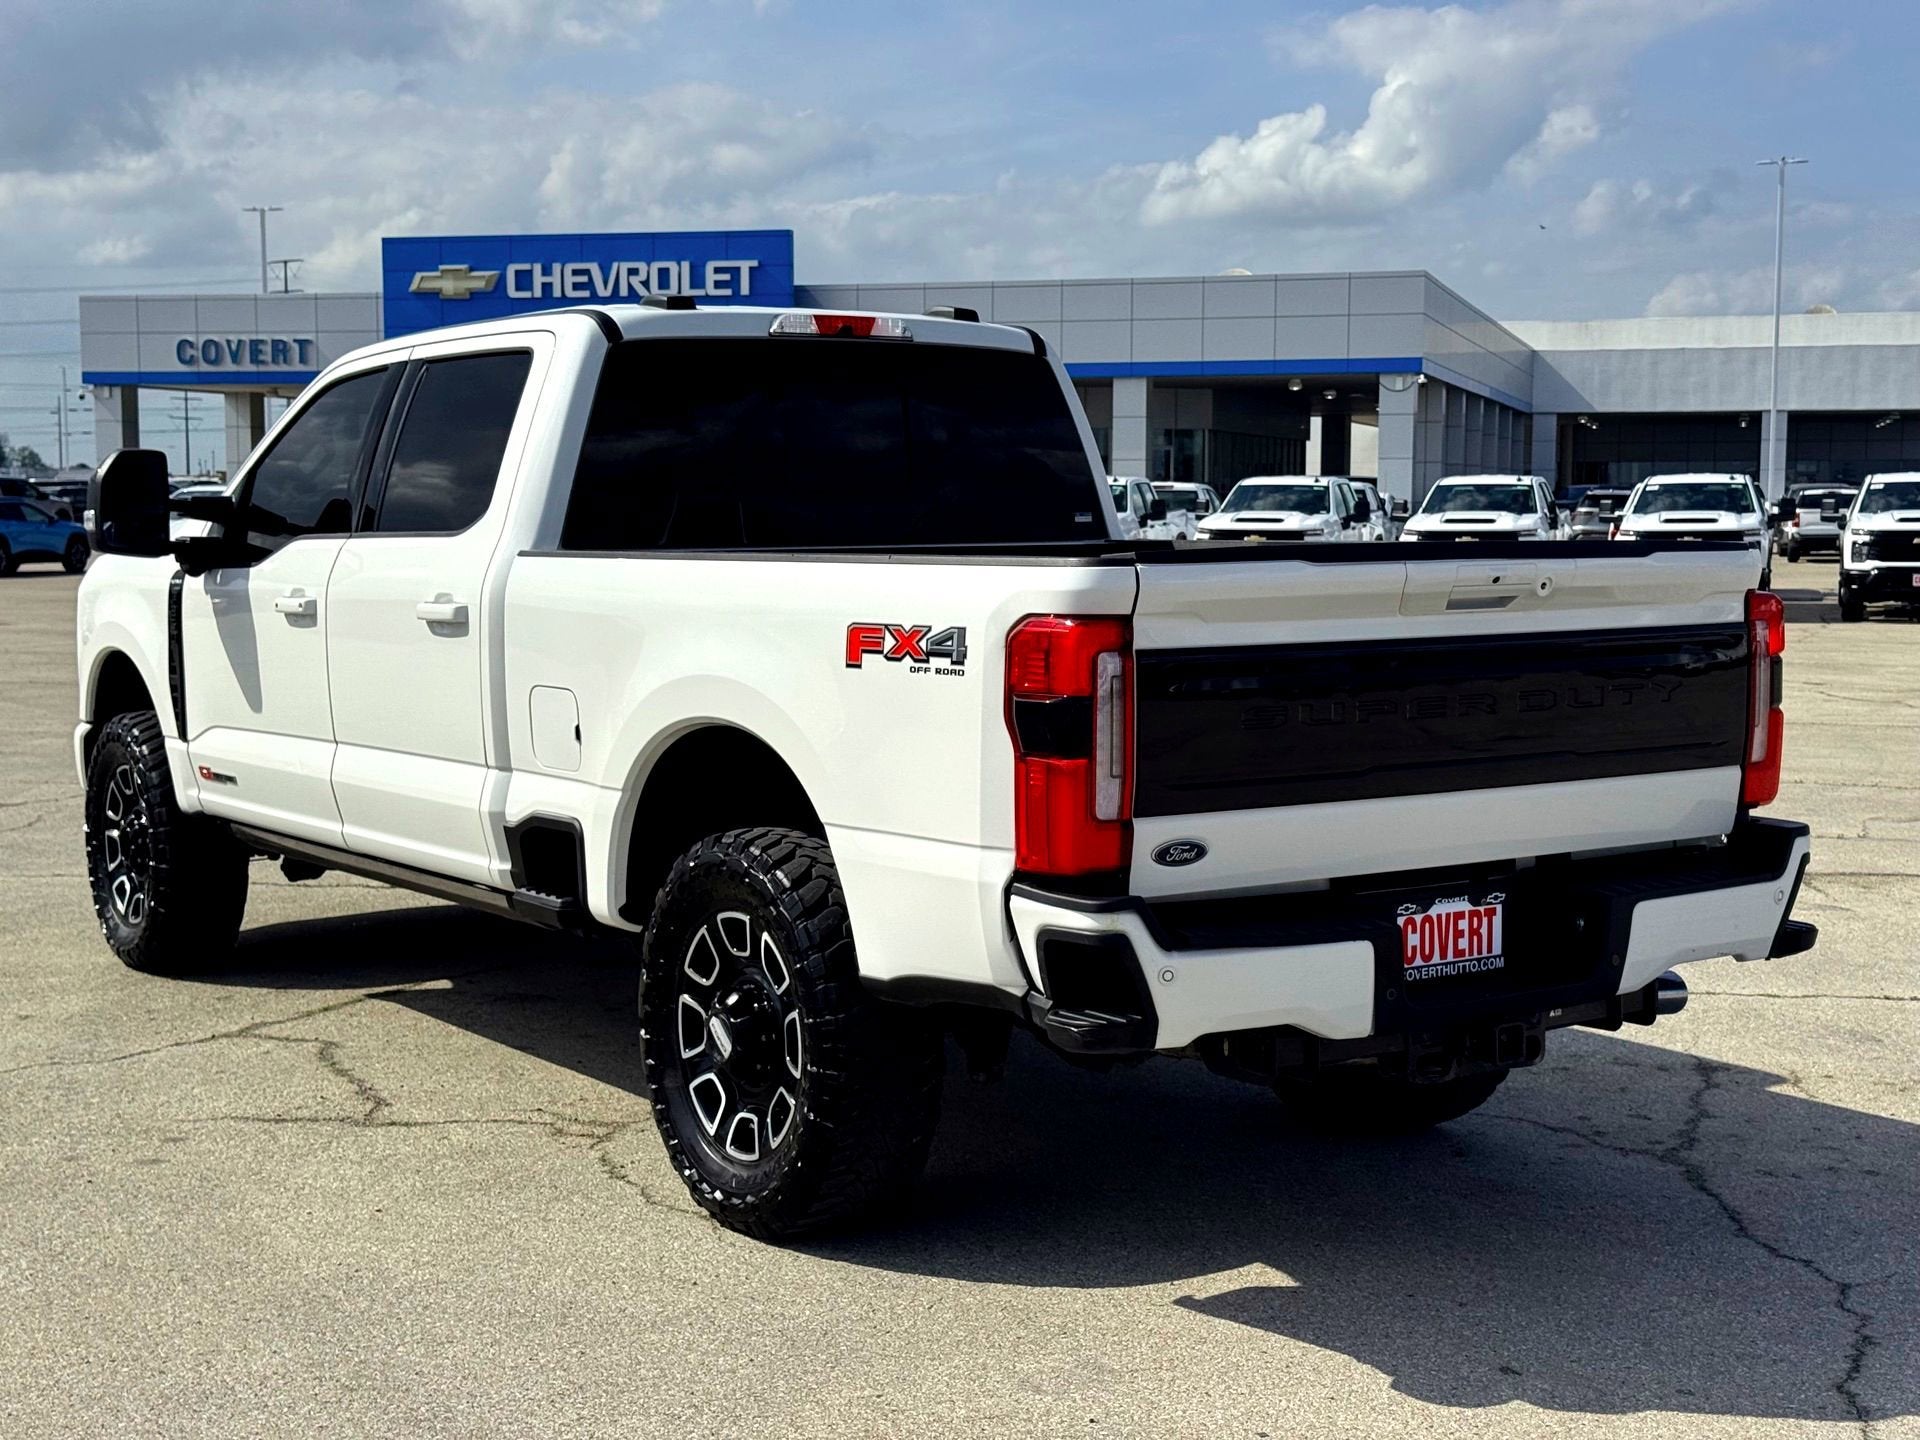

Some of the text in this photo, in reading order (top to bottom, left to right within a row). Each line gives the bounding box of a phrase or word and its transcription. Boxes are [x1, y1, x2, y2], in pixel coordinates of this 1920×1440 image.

[506, 259, 759, 298] CHEVROLET
[176, 338, 313, 366] COVERT
[846, 622, 967, 669] FX4
[909, 666, 965, 677] OFF ROAD
[1240, 679, 1683, 730] SUPER DUTY
[1166, 845, 1198, 861] Ford
[1435, 895, 1469, 905] Covert
[1402, 907, 1497, 966] COVERT
